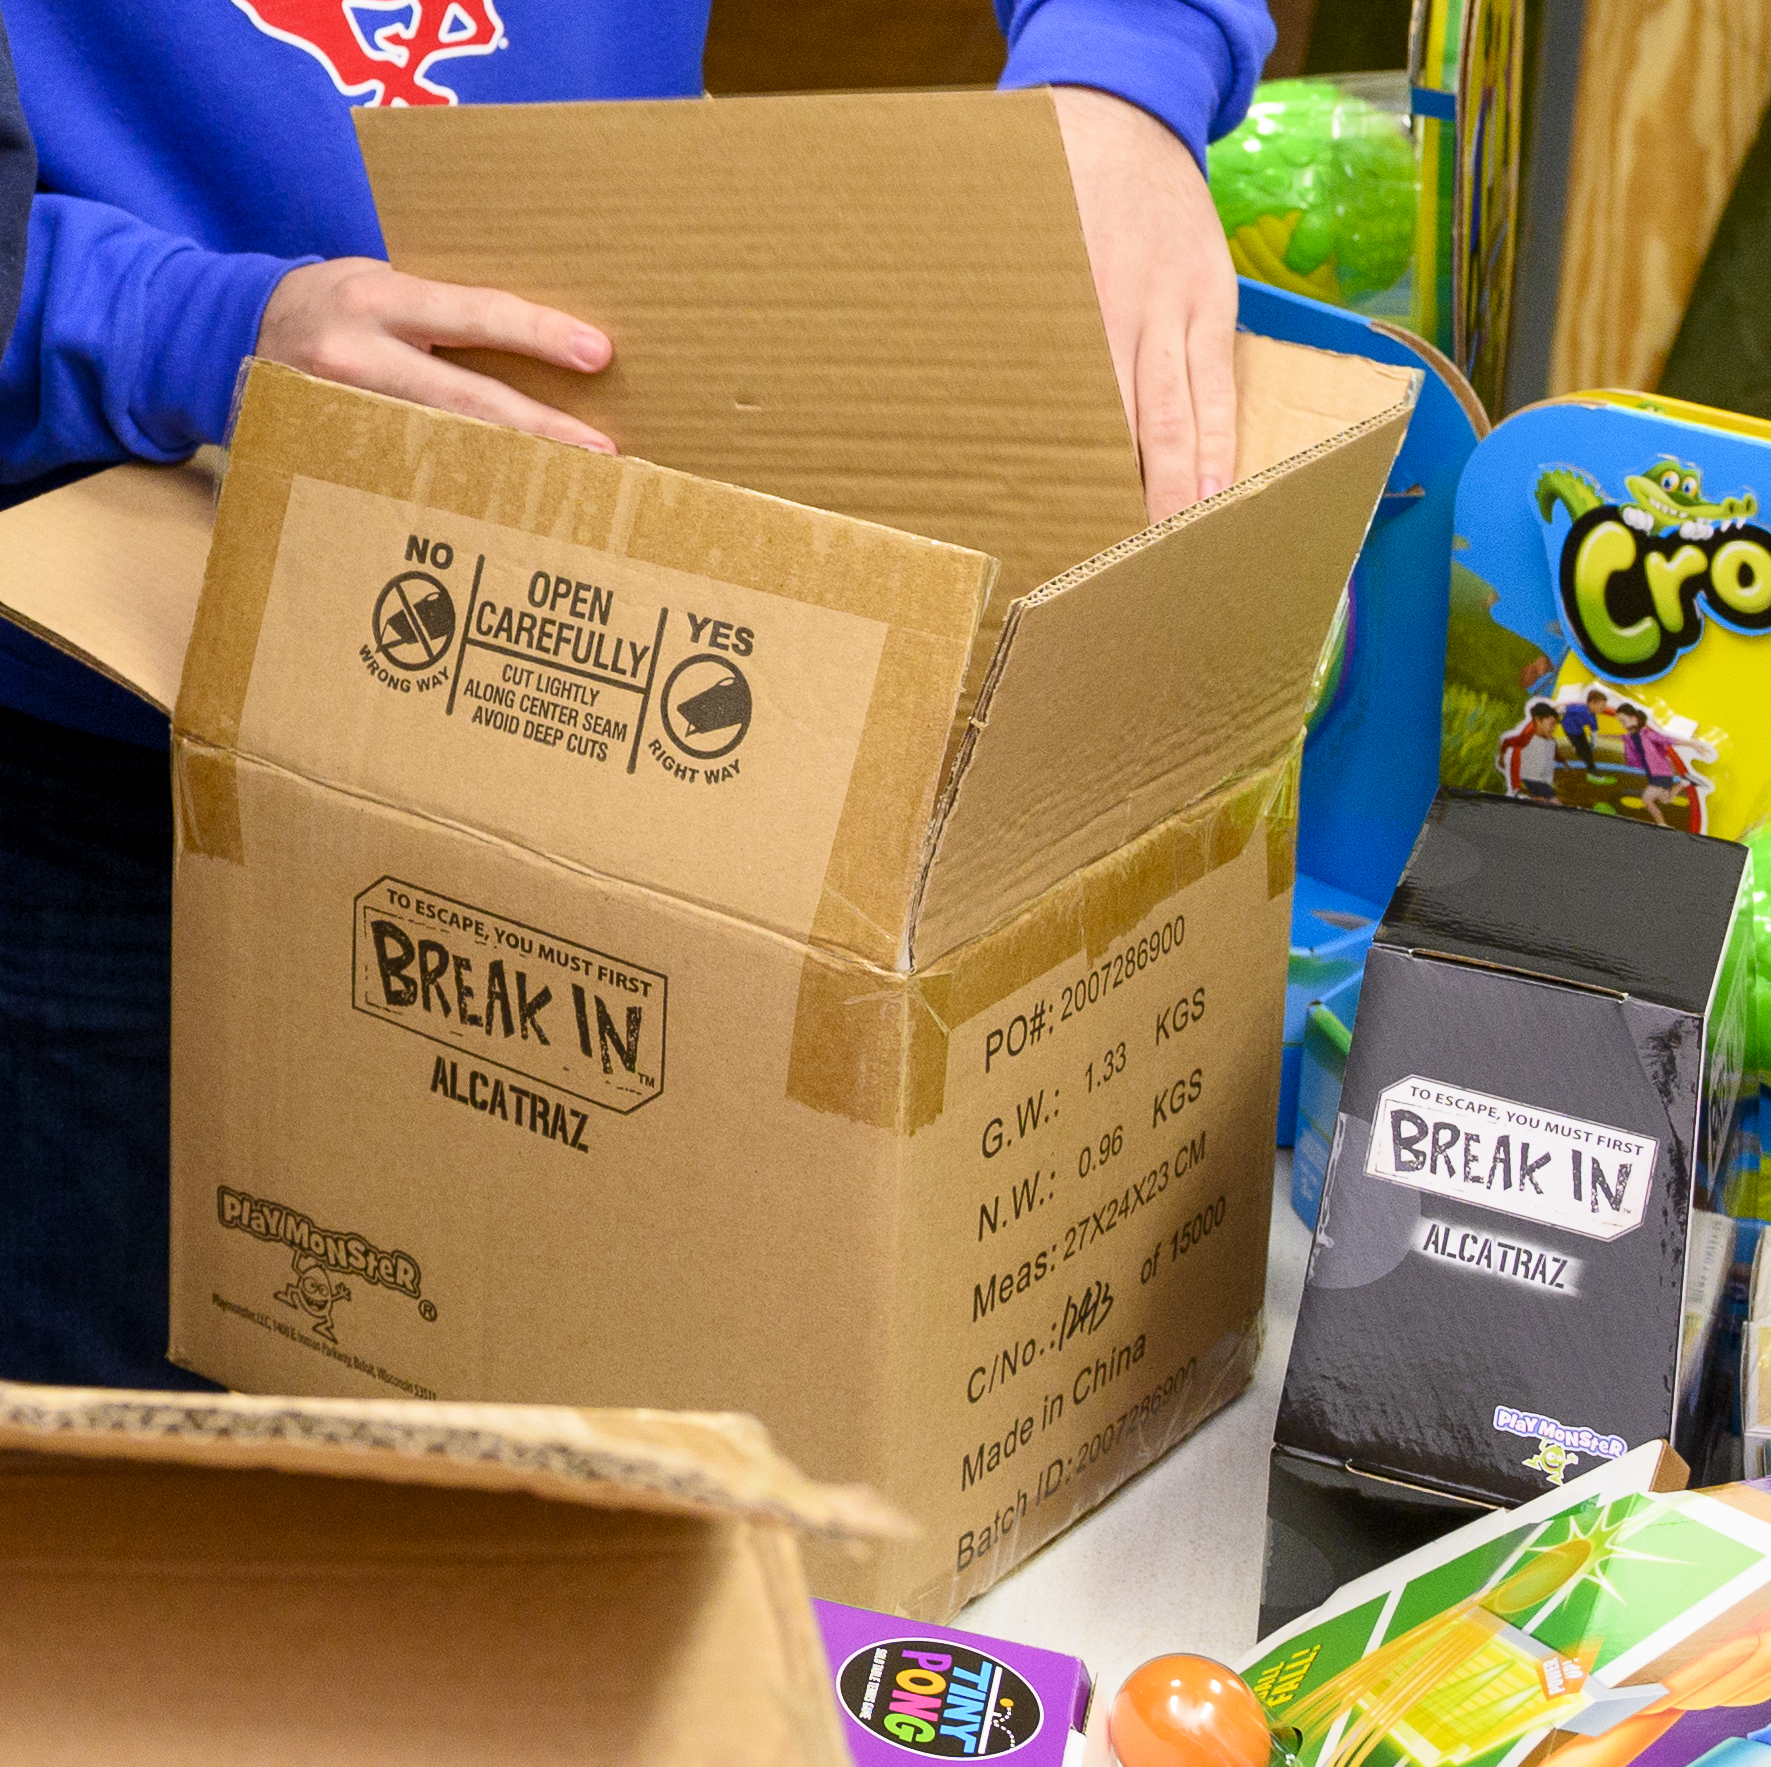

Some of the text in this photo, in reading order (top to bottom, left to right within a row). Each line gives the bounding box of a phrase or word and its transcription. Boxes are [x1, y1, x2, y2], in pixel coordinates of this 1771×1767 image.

[405, 534, 453, 570] NO
[476, 600, 650, 679] CAREFULLY
[527, 570, 613, 626] OPEN
[687, 612, 755, 657] YES
[359, 644, 450, 693] WRONG WAY
[464, 678, 628, 742] ALONG CENTER SEAM
[502, 663, 600, 707] CUT LIGHTLY
[472, 705, 608, 762] AVOID DEEP CUTS
[648, 738, 741, 785] RIGHT WAY
[387, 888, 652, 998] TO ESCAPE, YOU MUST FIRST
[370, 919, 552, 1046] BREAK
[571, 982, 642, 1075] IN
[985, 915, 1185, 1074] PO#: 2007286900
[1085, 1042, 1126, 1094] 1.33
[1156, 987, 1205, 1047] KGS
[430, 1055, 589, 1154] ALCATRAZ
[1078, 1125, 1124, 1178] 0.96
[1153, 1068, 1202, 1129] KGS
[1410, 1086, 1645, 1157] TO ESCAPE, YOU MUST FIRST
[1390, 1108, 1552, 1195] BREAK
[1571, 1148, 1632, 1214] IN
[972, 1244, 1058, 1323] Meas:
[1063, 1161, 1169, 1262] 27X24X23
[1174, 1131, 1206, 1178] CM
[1140, 1195, 1226, 1285] of 15000
[1422, 1223, 1568, 1289] ALCATRAZ
[961, 1334, 1146, 1492] Made in China
[956, 1489, 1027, 1573] Batch
[1035, 1458, 1072, 1506] ID:
[883, 1649, 953, 1743] PONG
[939, 1660, 993, 1753] TINY
